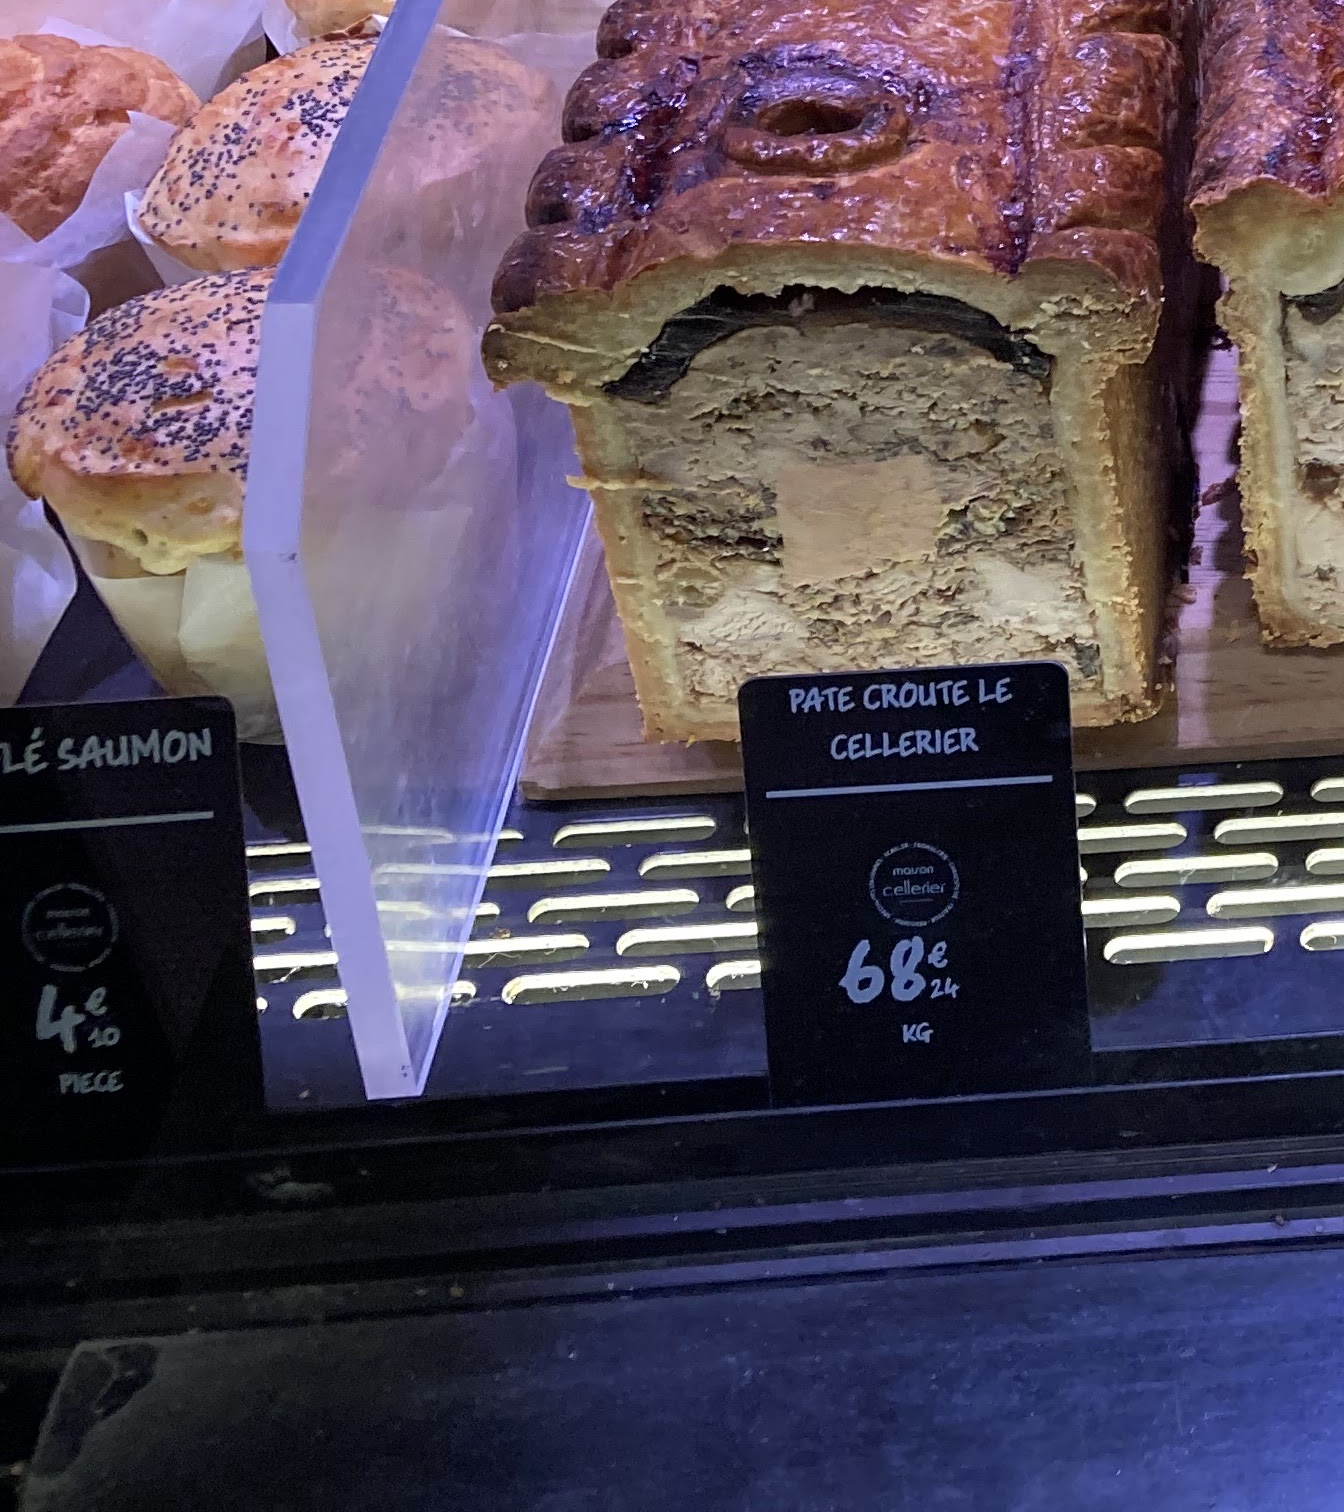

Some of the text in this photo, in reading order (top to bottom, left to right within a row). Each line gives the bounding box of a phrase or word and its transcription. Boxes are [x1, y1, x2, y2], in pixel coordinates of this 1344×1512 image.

[789, 677, 1013, 714] PATE CROUTE LE
[57, 728, 212, 771] SAUMON
[830, 727, 979, 761] CELLERIER
[902, 1022, 934, 1043] KG
[59, 1071, 124, 1094] PIECE
